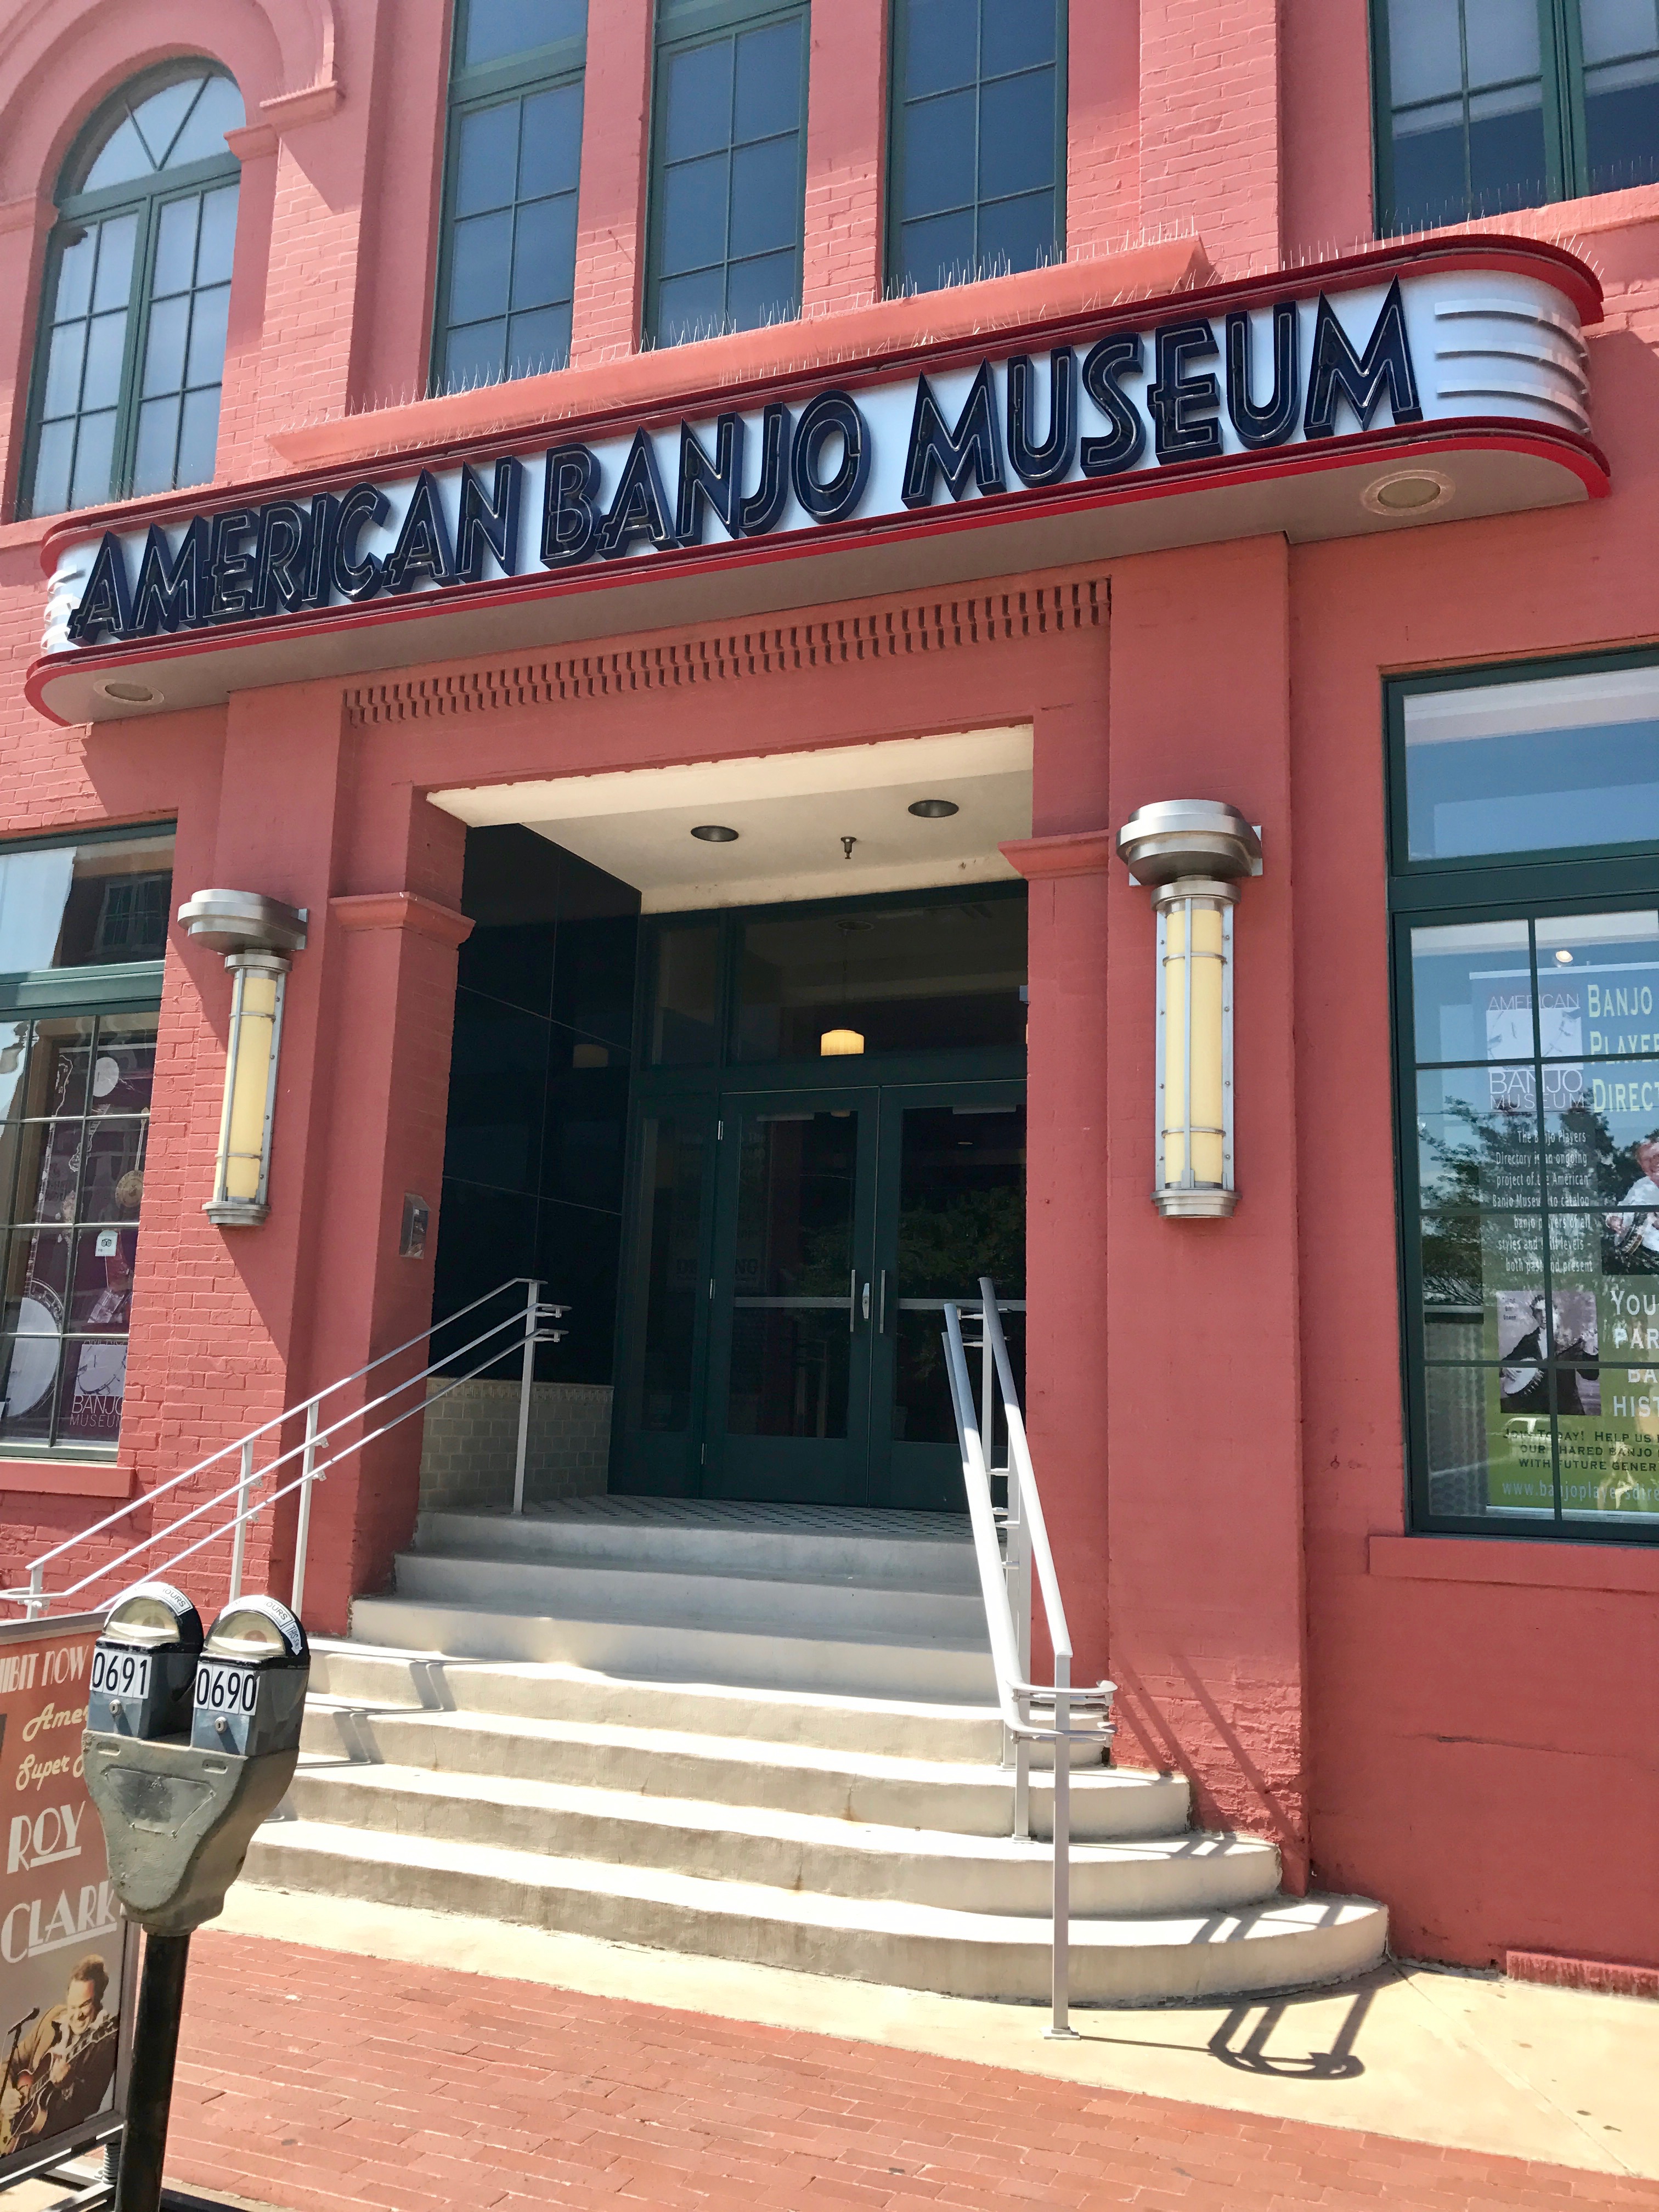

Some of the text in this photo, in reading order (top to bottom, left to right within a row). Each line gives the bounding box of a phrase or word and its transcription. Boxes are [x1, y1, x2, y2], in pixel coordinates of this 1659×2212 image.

[66, 274, 1423, 646] AMERICAN BANJO MUSEUM
[1588, 984, 1652, 1018] BANJO
[1489, 1070, 1583, 1094] BANJO
[1534, 1130, 1555, 1146] Bjo
[1496, 1151, 1531, 1167] Directory
[1556, 1151, 1587, 1167] ongoing
[1497, 1173, 1523, 1189] project
[1553, 1172, 1589, 1186] American
[1492, 1194, 1514, 1207] Banjo
[1516, 1194, 1542, 1207] Museu
[1514, 1214, 1536, 1231] banjo
[1505, 1257, 1523, 1272] both
[1594, 1431, 1629, 1442] HELP
[1635, 1434, 1651, 1443] US
[1520, 1444, 1546, 1454] OUR
[1559, 1446, 1603, 1456] HARED
[1519, 1459, 1551, 1468] WITH
[264, 1601, 288, 1621] OURS
[92, 1652, 148, 1695] 0691
[196, 1668, 257, 1712] 0690
[15, 1754, 71, 1791] Super
[7, 1800, 86, 1874] ROY
[1, 1881, 116, 1963] CLARK
